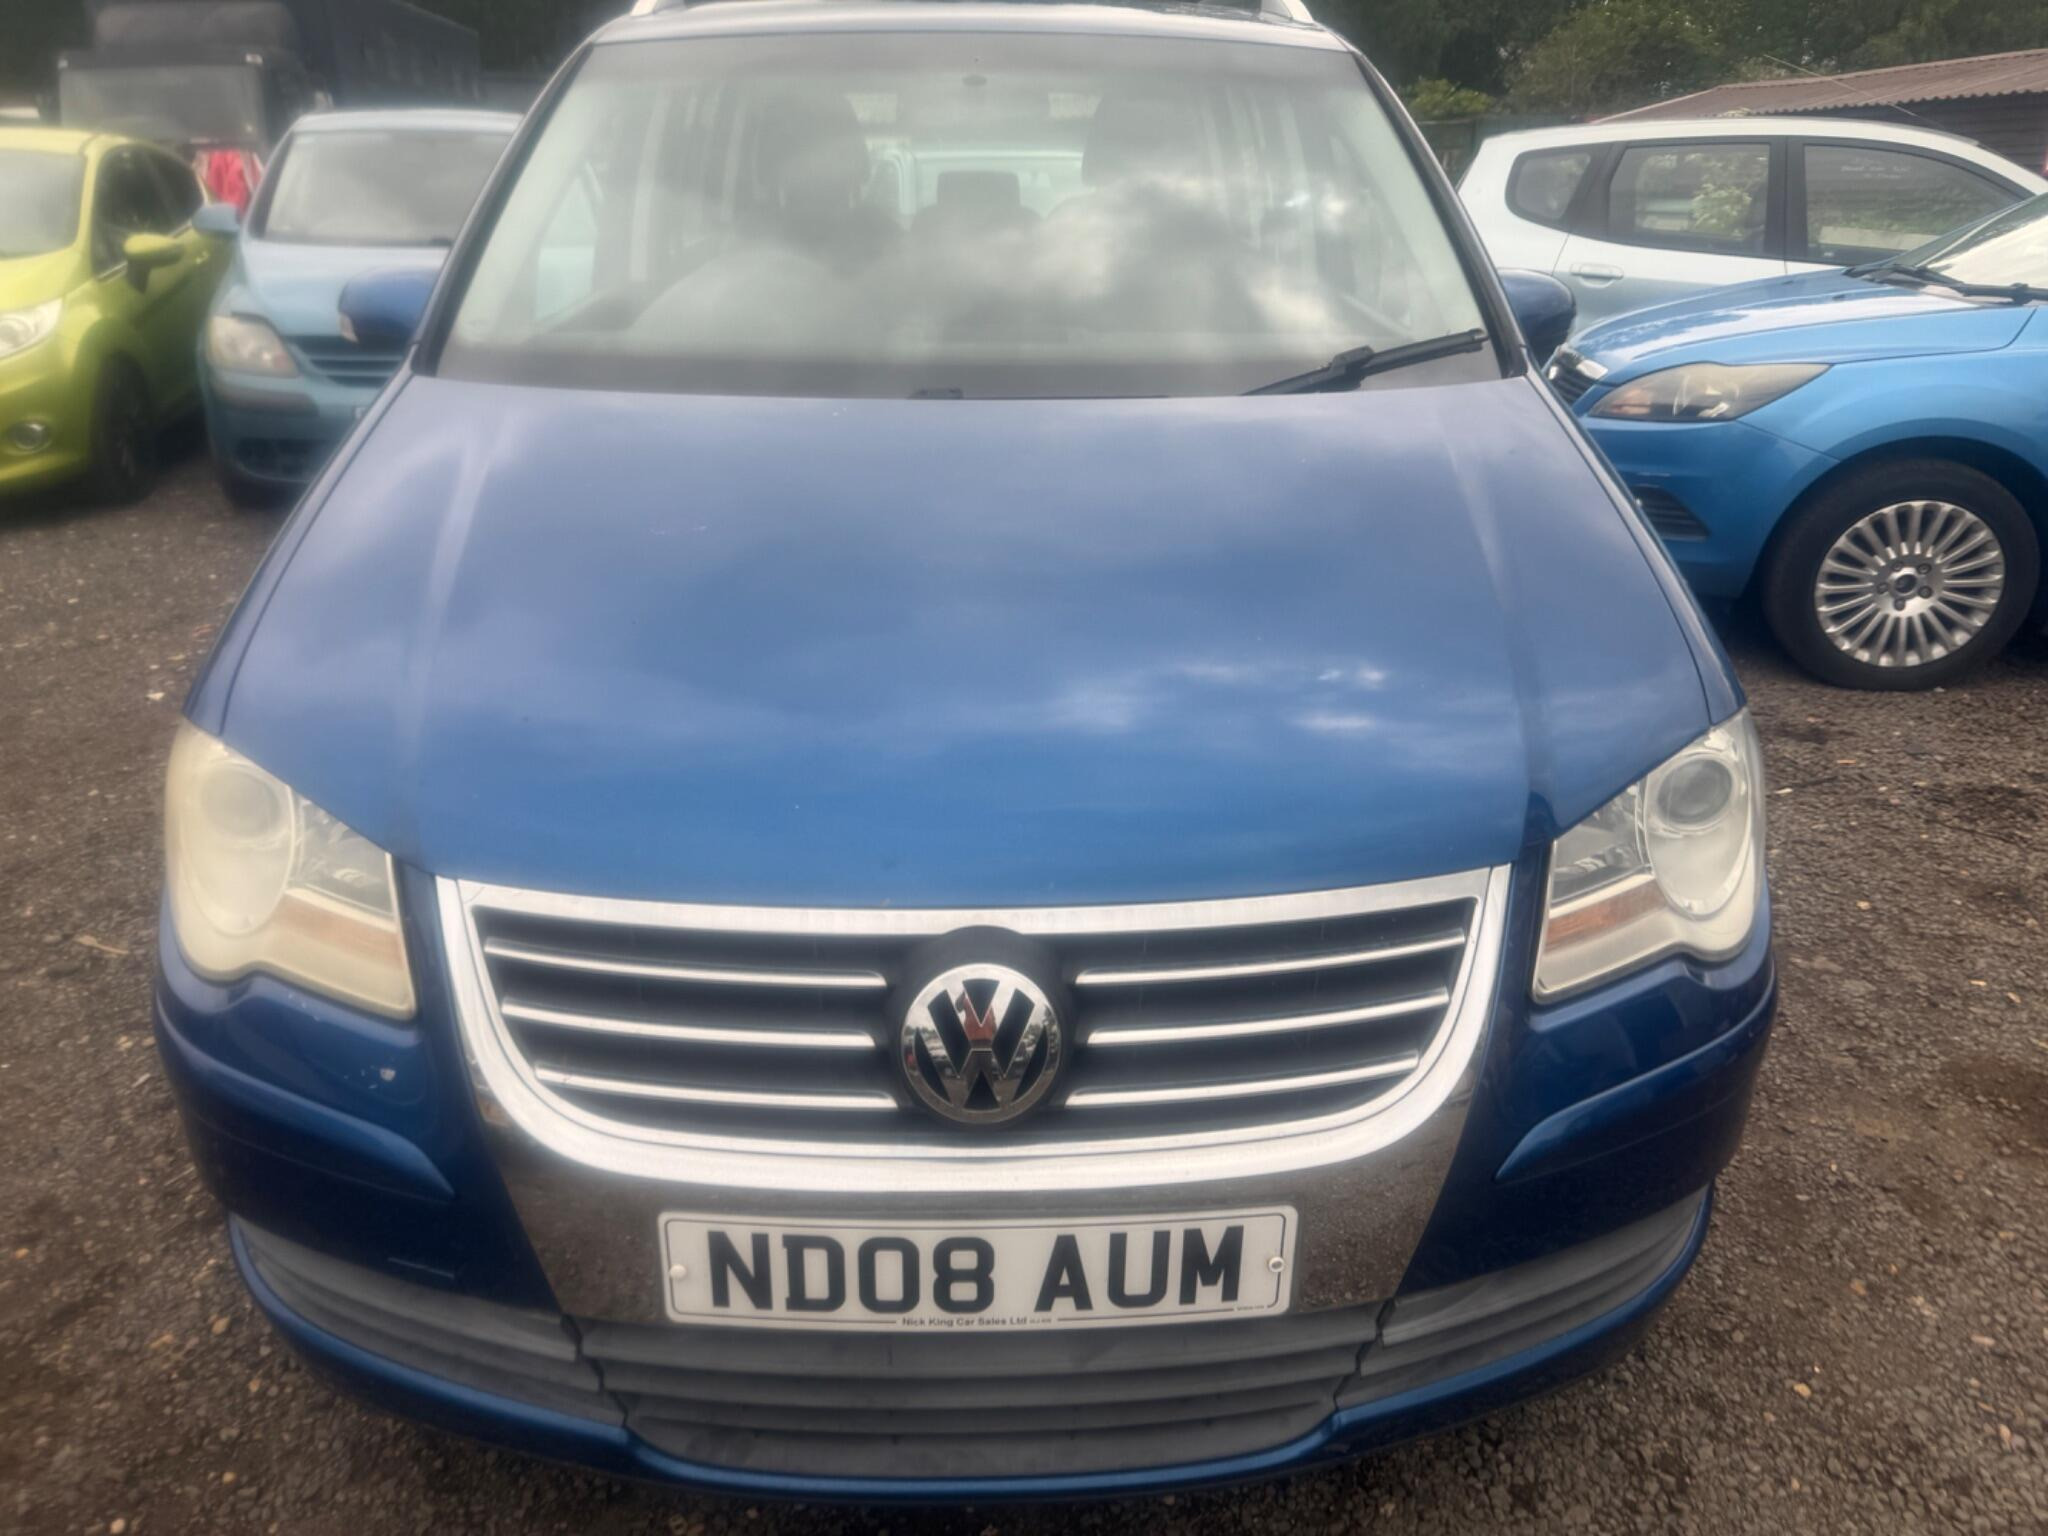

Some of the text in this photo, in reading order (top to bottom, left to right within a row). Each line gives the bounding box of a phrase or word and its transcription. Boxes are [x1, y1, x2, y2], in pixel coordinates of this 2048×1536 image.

[903, 964, 1061, 1123] VW
[707, 1225, 1244, 1313] ND08 AUM
[902, 1317, 925, 1326] Nick
[928, 1317, 954, 1327] King
[956, 1317, 975, 1326] Car
[978, 1317, 1006, 1326] Sales
[1009, 1316, 1027, 1326] Ltd
